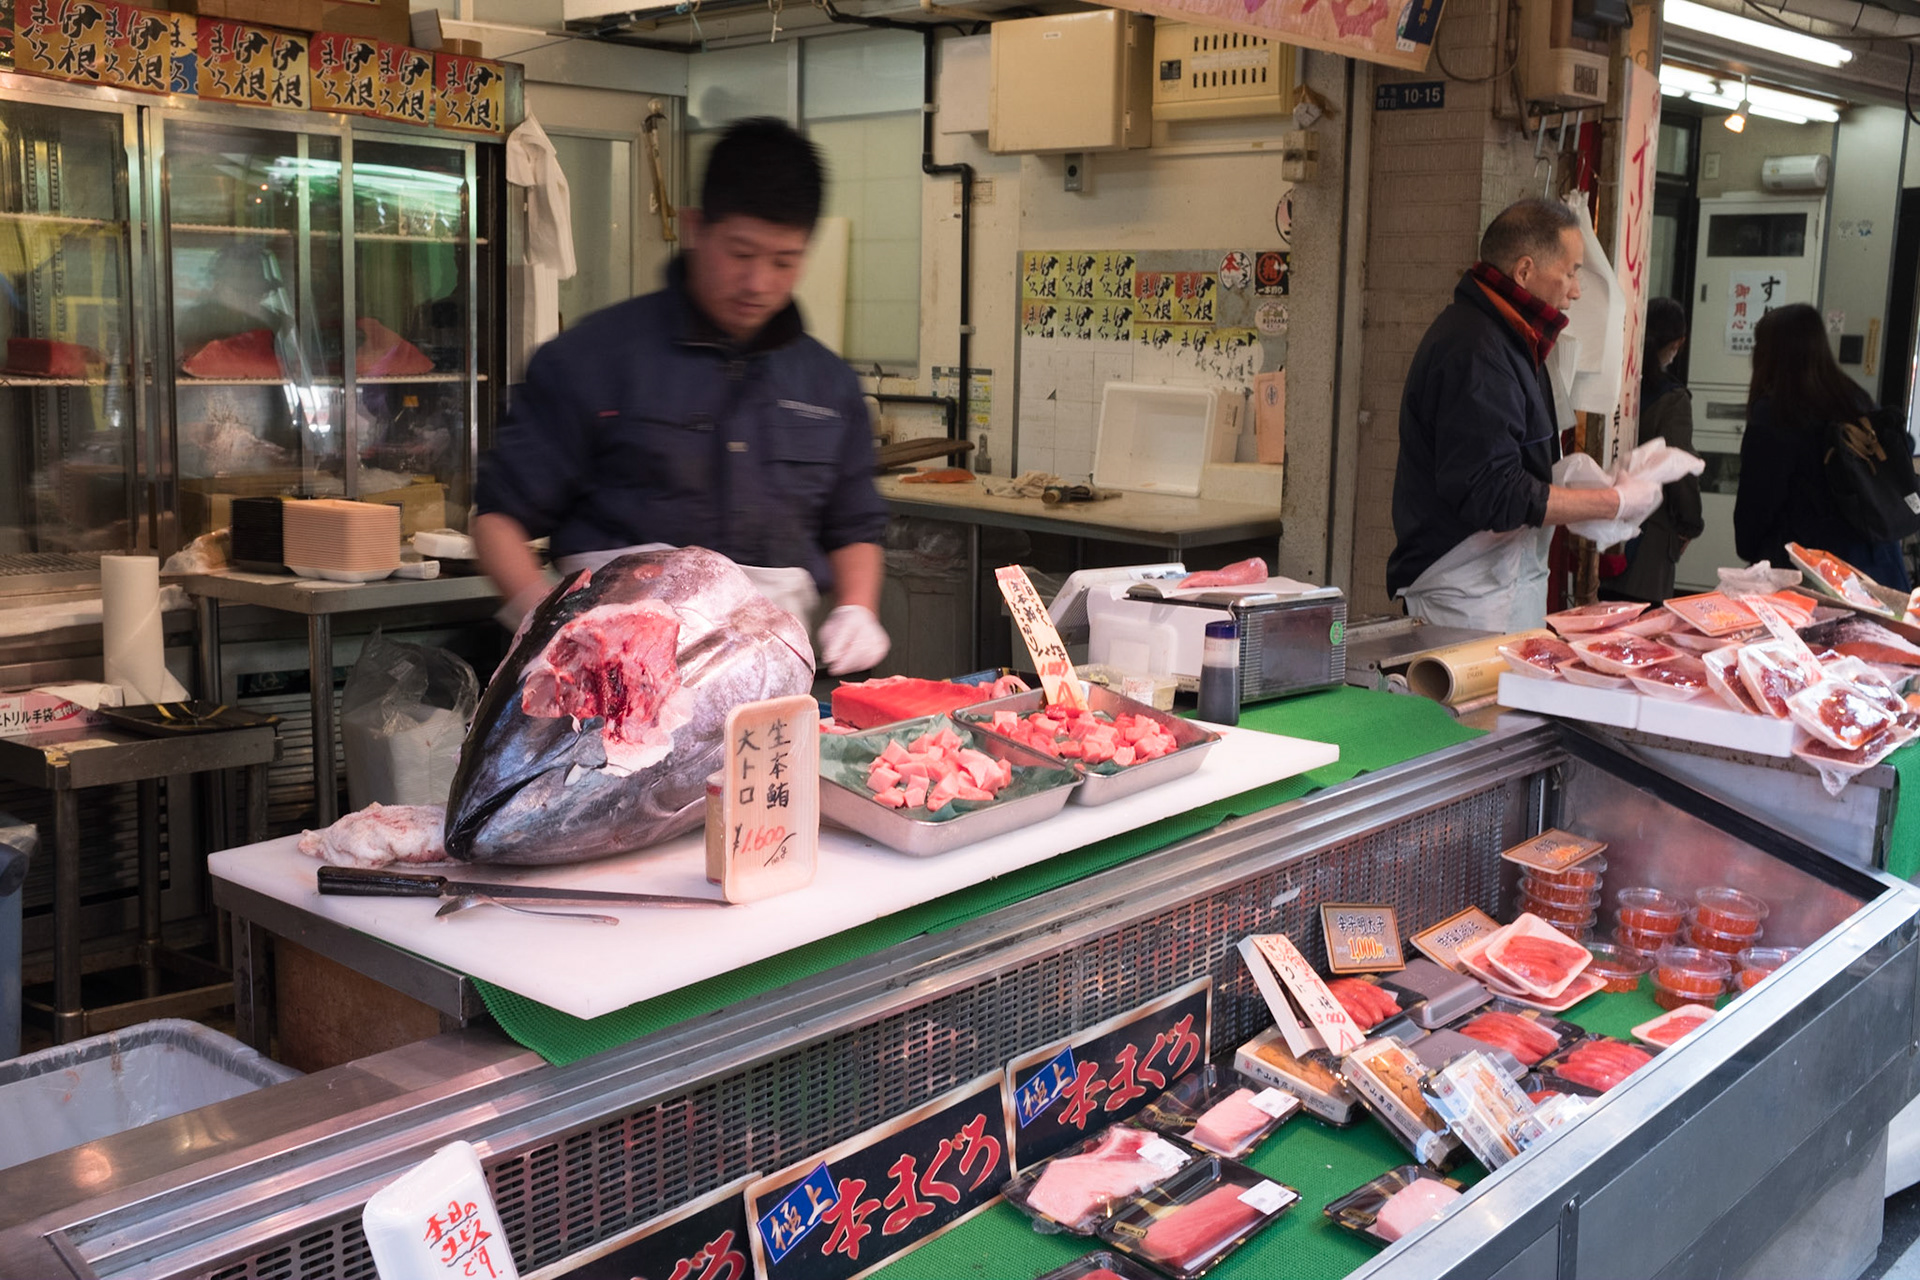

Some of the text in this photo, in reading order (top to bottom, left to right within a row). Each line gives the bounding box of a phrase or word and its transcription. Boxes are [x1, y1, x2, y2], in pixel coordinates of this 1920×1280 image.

[203, 24, 230, 95] まぐろ
[315, 36, 342, 105] まぐろ
[440, 61, 461, 124] まぐろ
[1404, 87, 1441, 103] 10-15
[1731, 283, 1751, 330] 御用心
[736, 730, 760, 804] 大トロ
[767, 718, 790, 809] 生本鮪
[1023, 1013, 1200, 1130] 極上 本まぐろ
[771, 1113, 1001, 1260] 極上 本まぐろ
